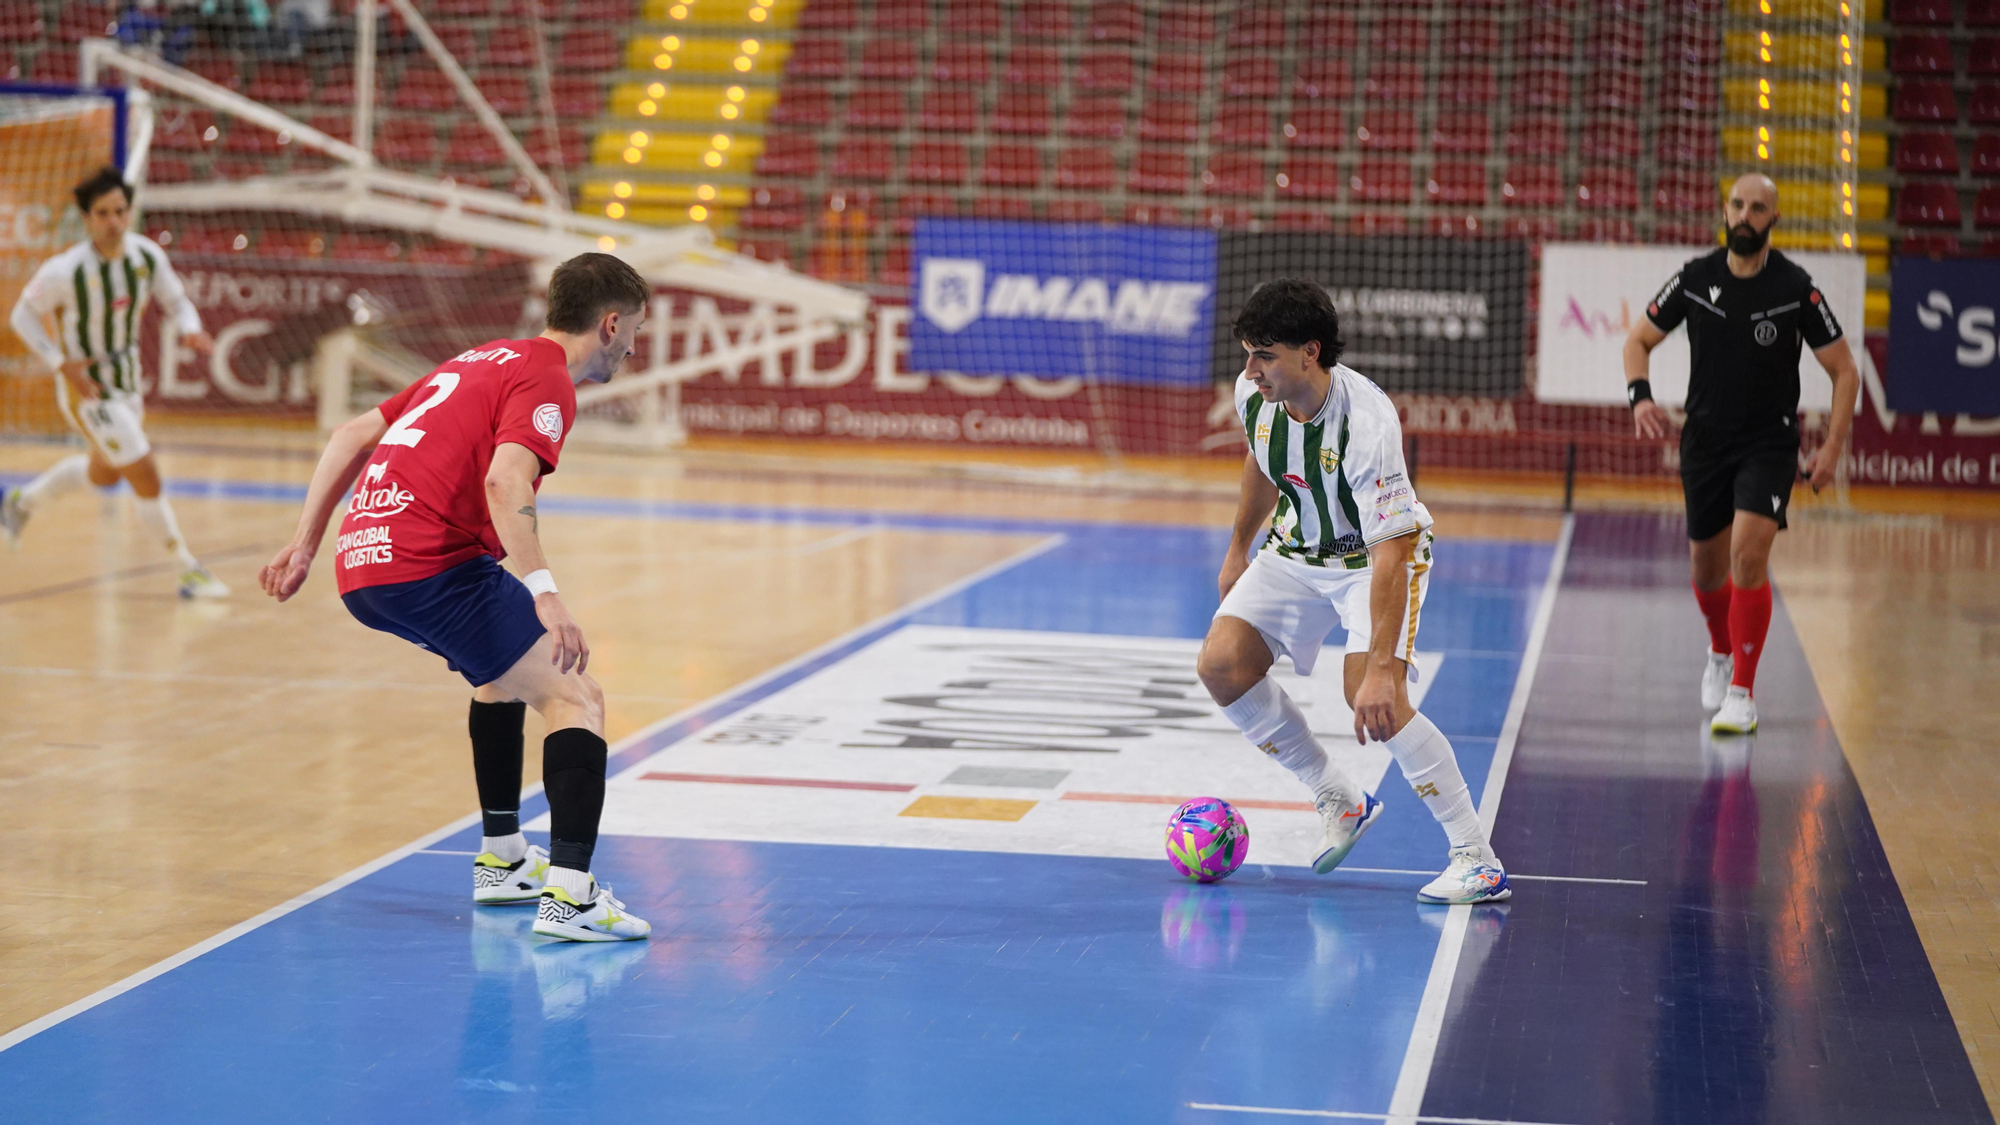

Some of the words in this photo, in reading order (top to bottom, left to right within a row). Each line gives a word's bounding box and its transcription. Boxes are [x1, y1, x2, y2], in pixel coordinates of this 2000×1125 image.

[985, 274, 1211, 322] IMANE
[379, 372, 461, 449] 2
[1942, 451, 1980, 485] de
[353, 526, 392, 548] GLOBAL
[344, 545, 393, 570] LOGISTICS
